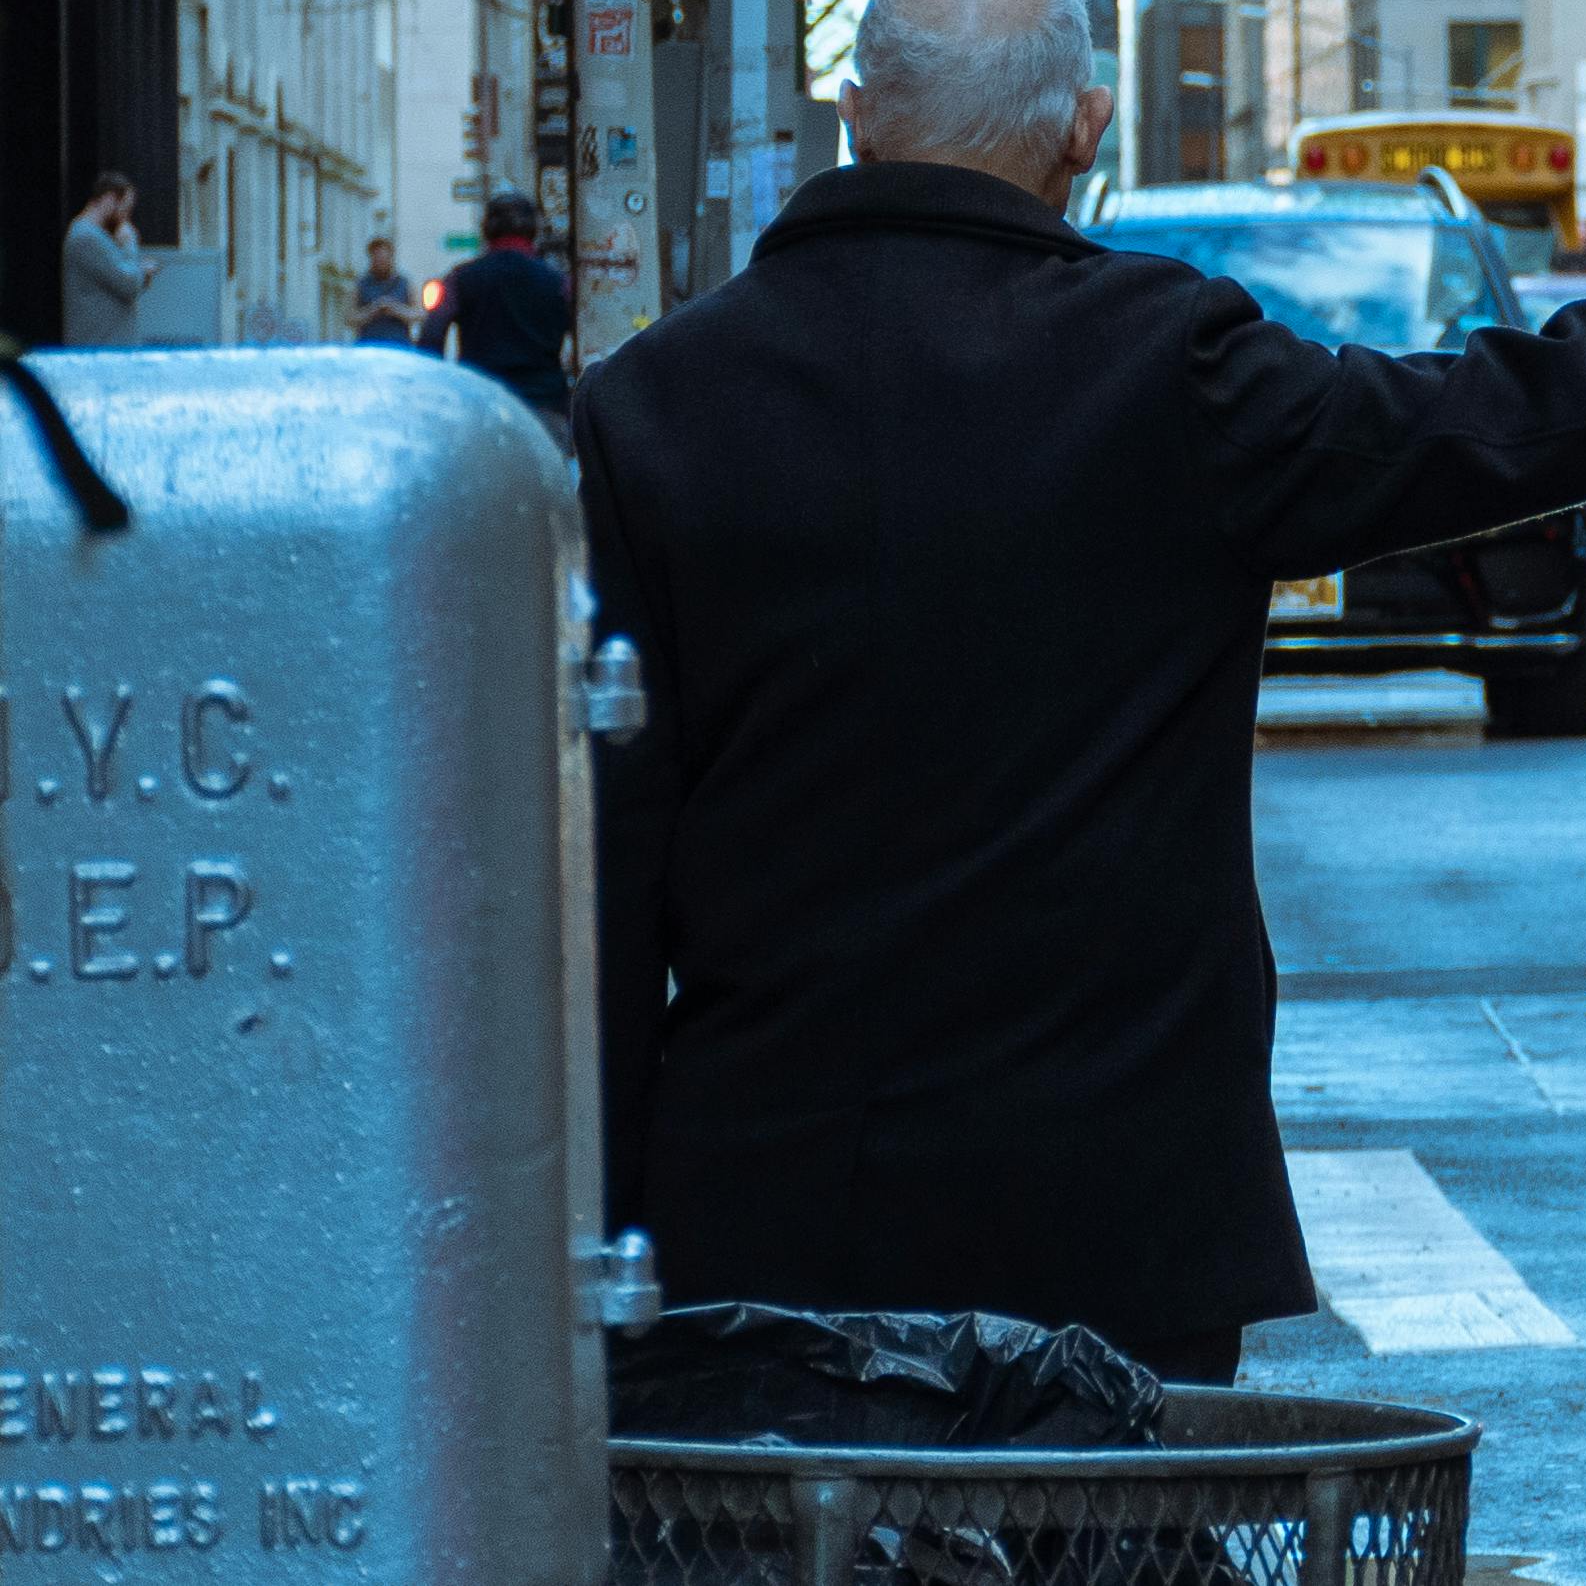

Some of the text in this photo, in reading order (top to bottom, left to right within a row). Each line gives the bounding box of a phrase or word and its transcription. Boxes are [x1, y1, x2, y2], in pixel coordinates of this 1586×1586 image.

[0, 676, 291, 805] .Y.C.
[0, 857, 292, 982] .E.P.
[259, 1475, 367, 1552] INC
